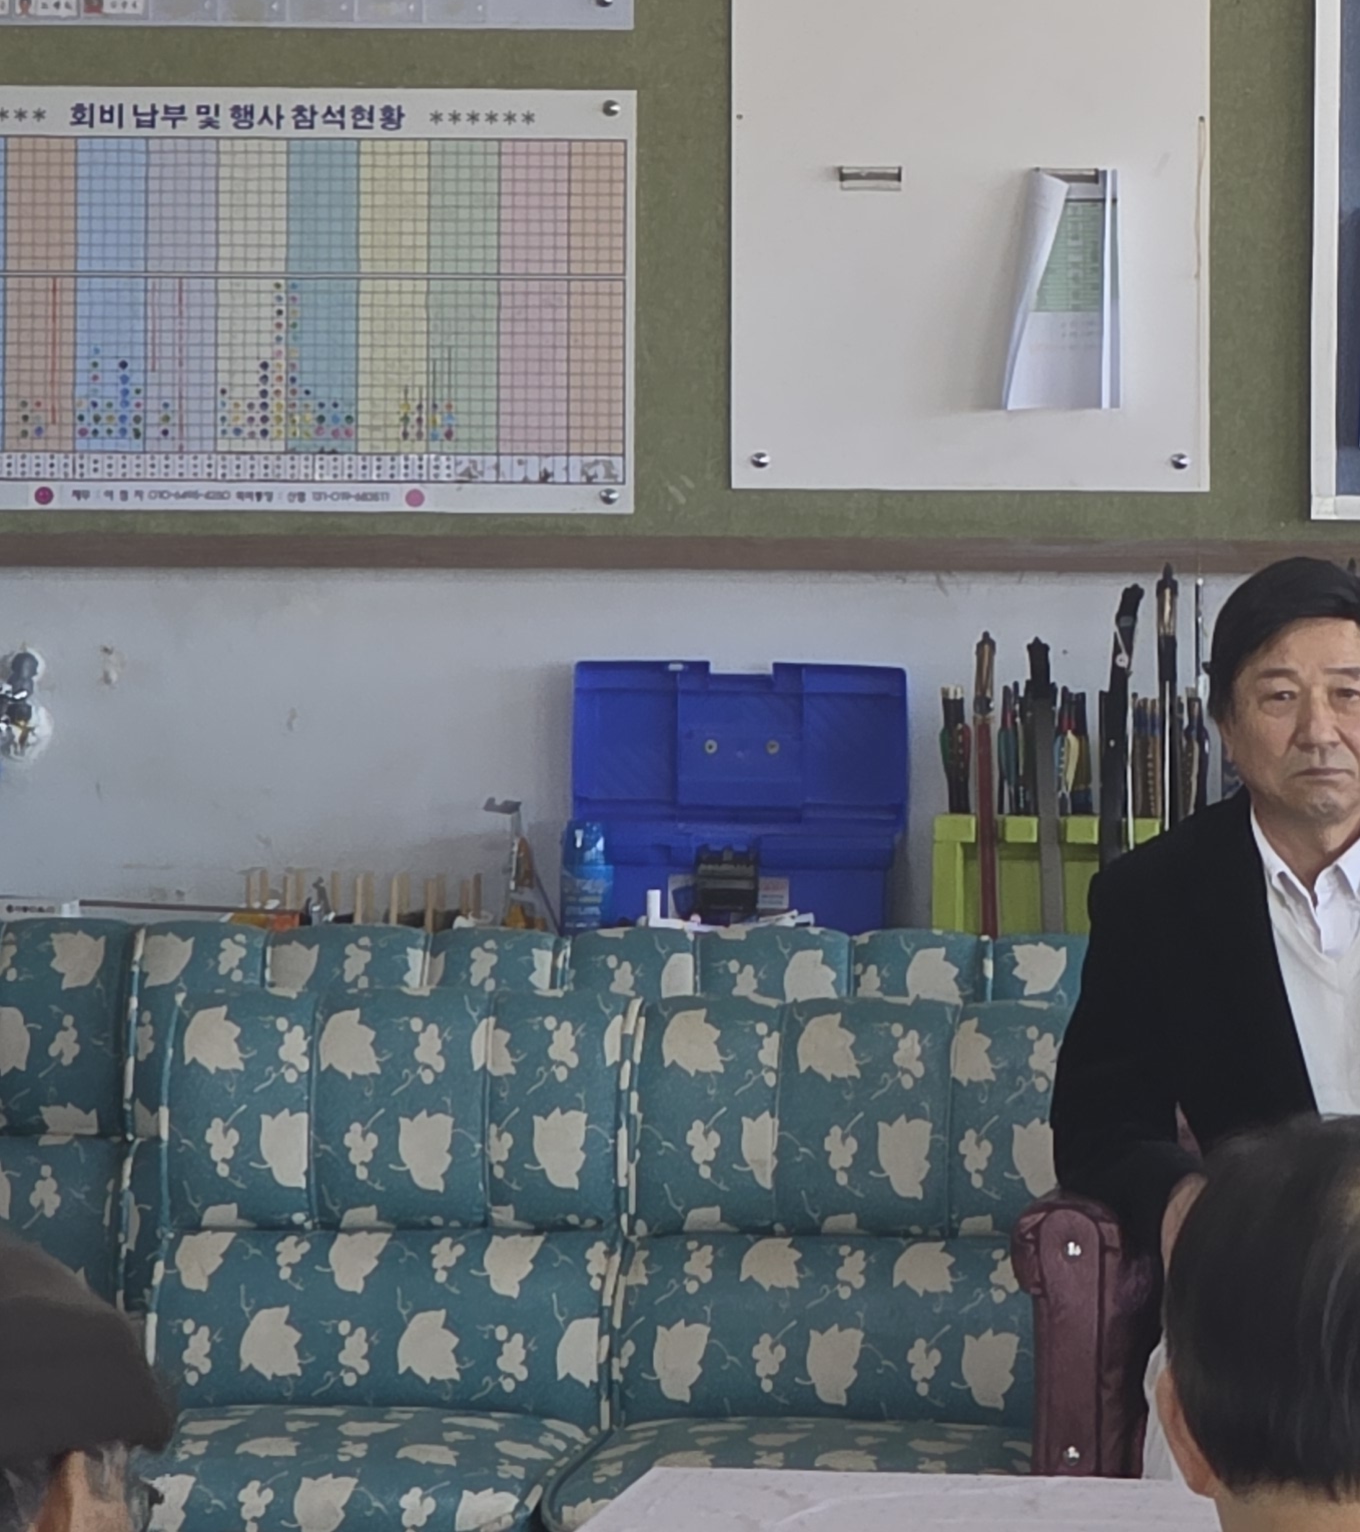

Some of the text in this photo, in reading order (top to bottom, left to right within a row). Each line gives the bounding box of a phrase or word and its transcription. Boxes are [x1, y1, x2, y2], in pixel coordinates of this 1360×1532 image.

[70, 103, 405, 131] 회비 납부 및 행사 참석현황
